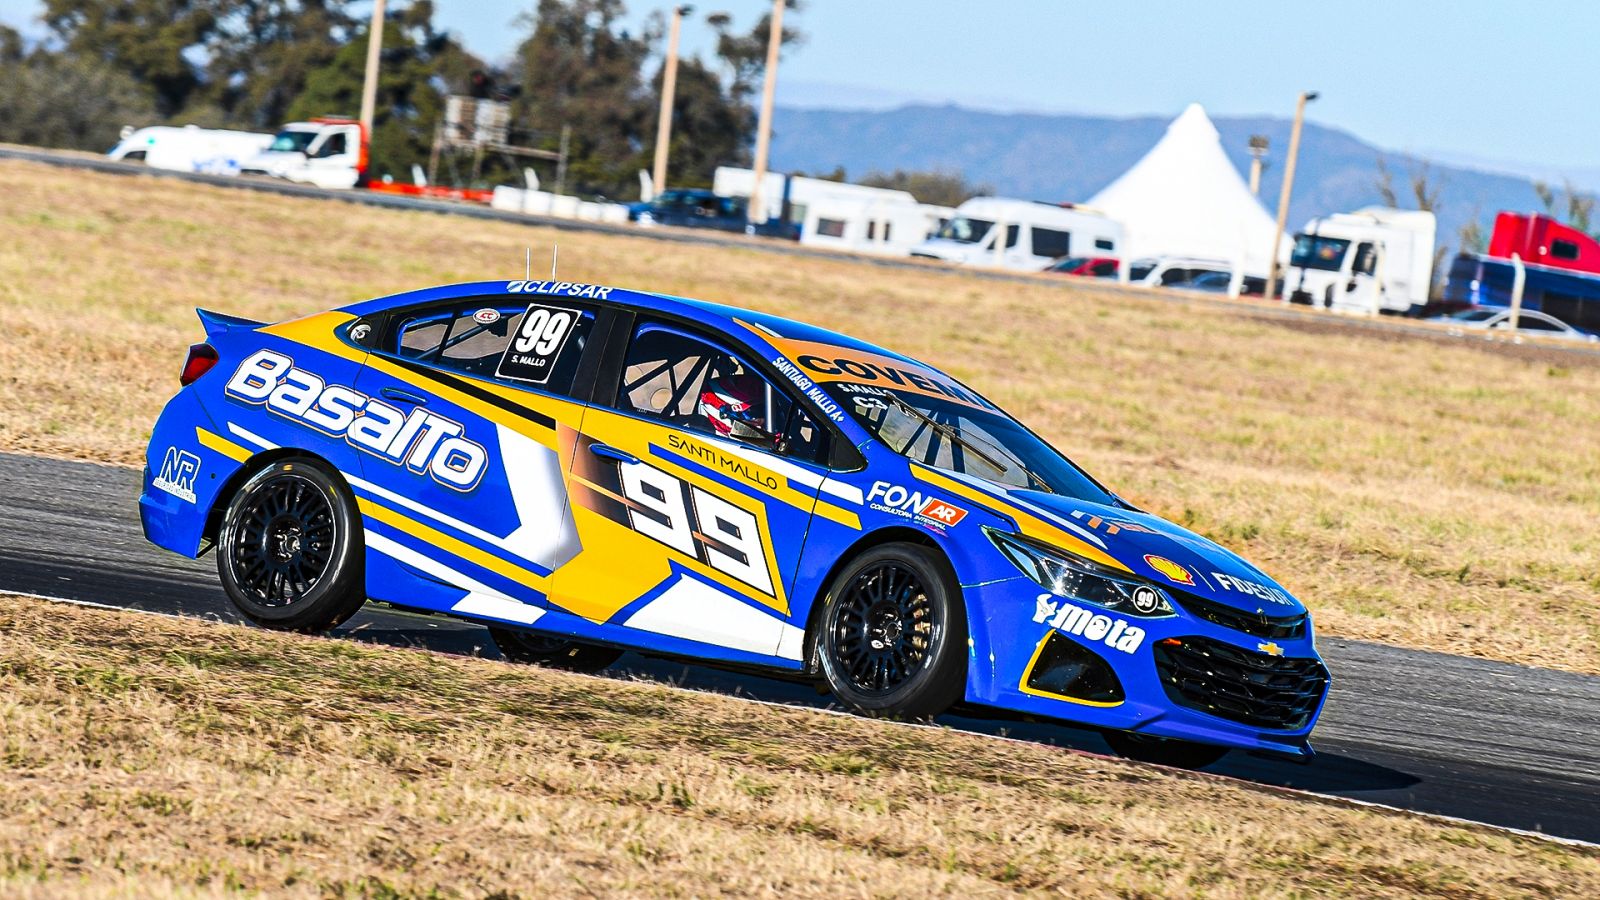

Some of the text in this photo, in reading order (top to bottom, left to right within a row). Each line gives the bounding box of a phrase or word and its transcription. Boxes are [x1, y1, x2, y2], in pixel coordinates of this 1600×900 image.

[523, 281, 614, 300] CLIPSAR
[515, 309, 571, 356] 99
[520, 356, 546, 367] MALLO
[772, 356, 813, 391] SANTIAGO
[806, 386, 837, 414] MALLO
[668, 434, 778, 490] SANTI MALLO
[619, 461, 778, 600] 99
[1136, 591, 1155, 608] 99
